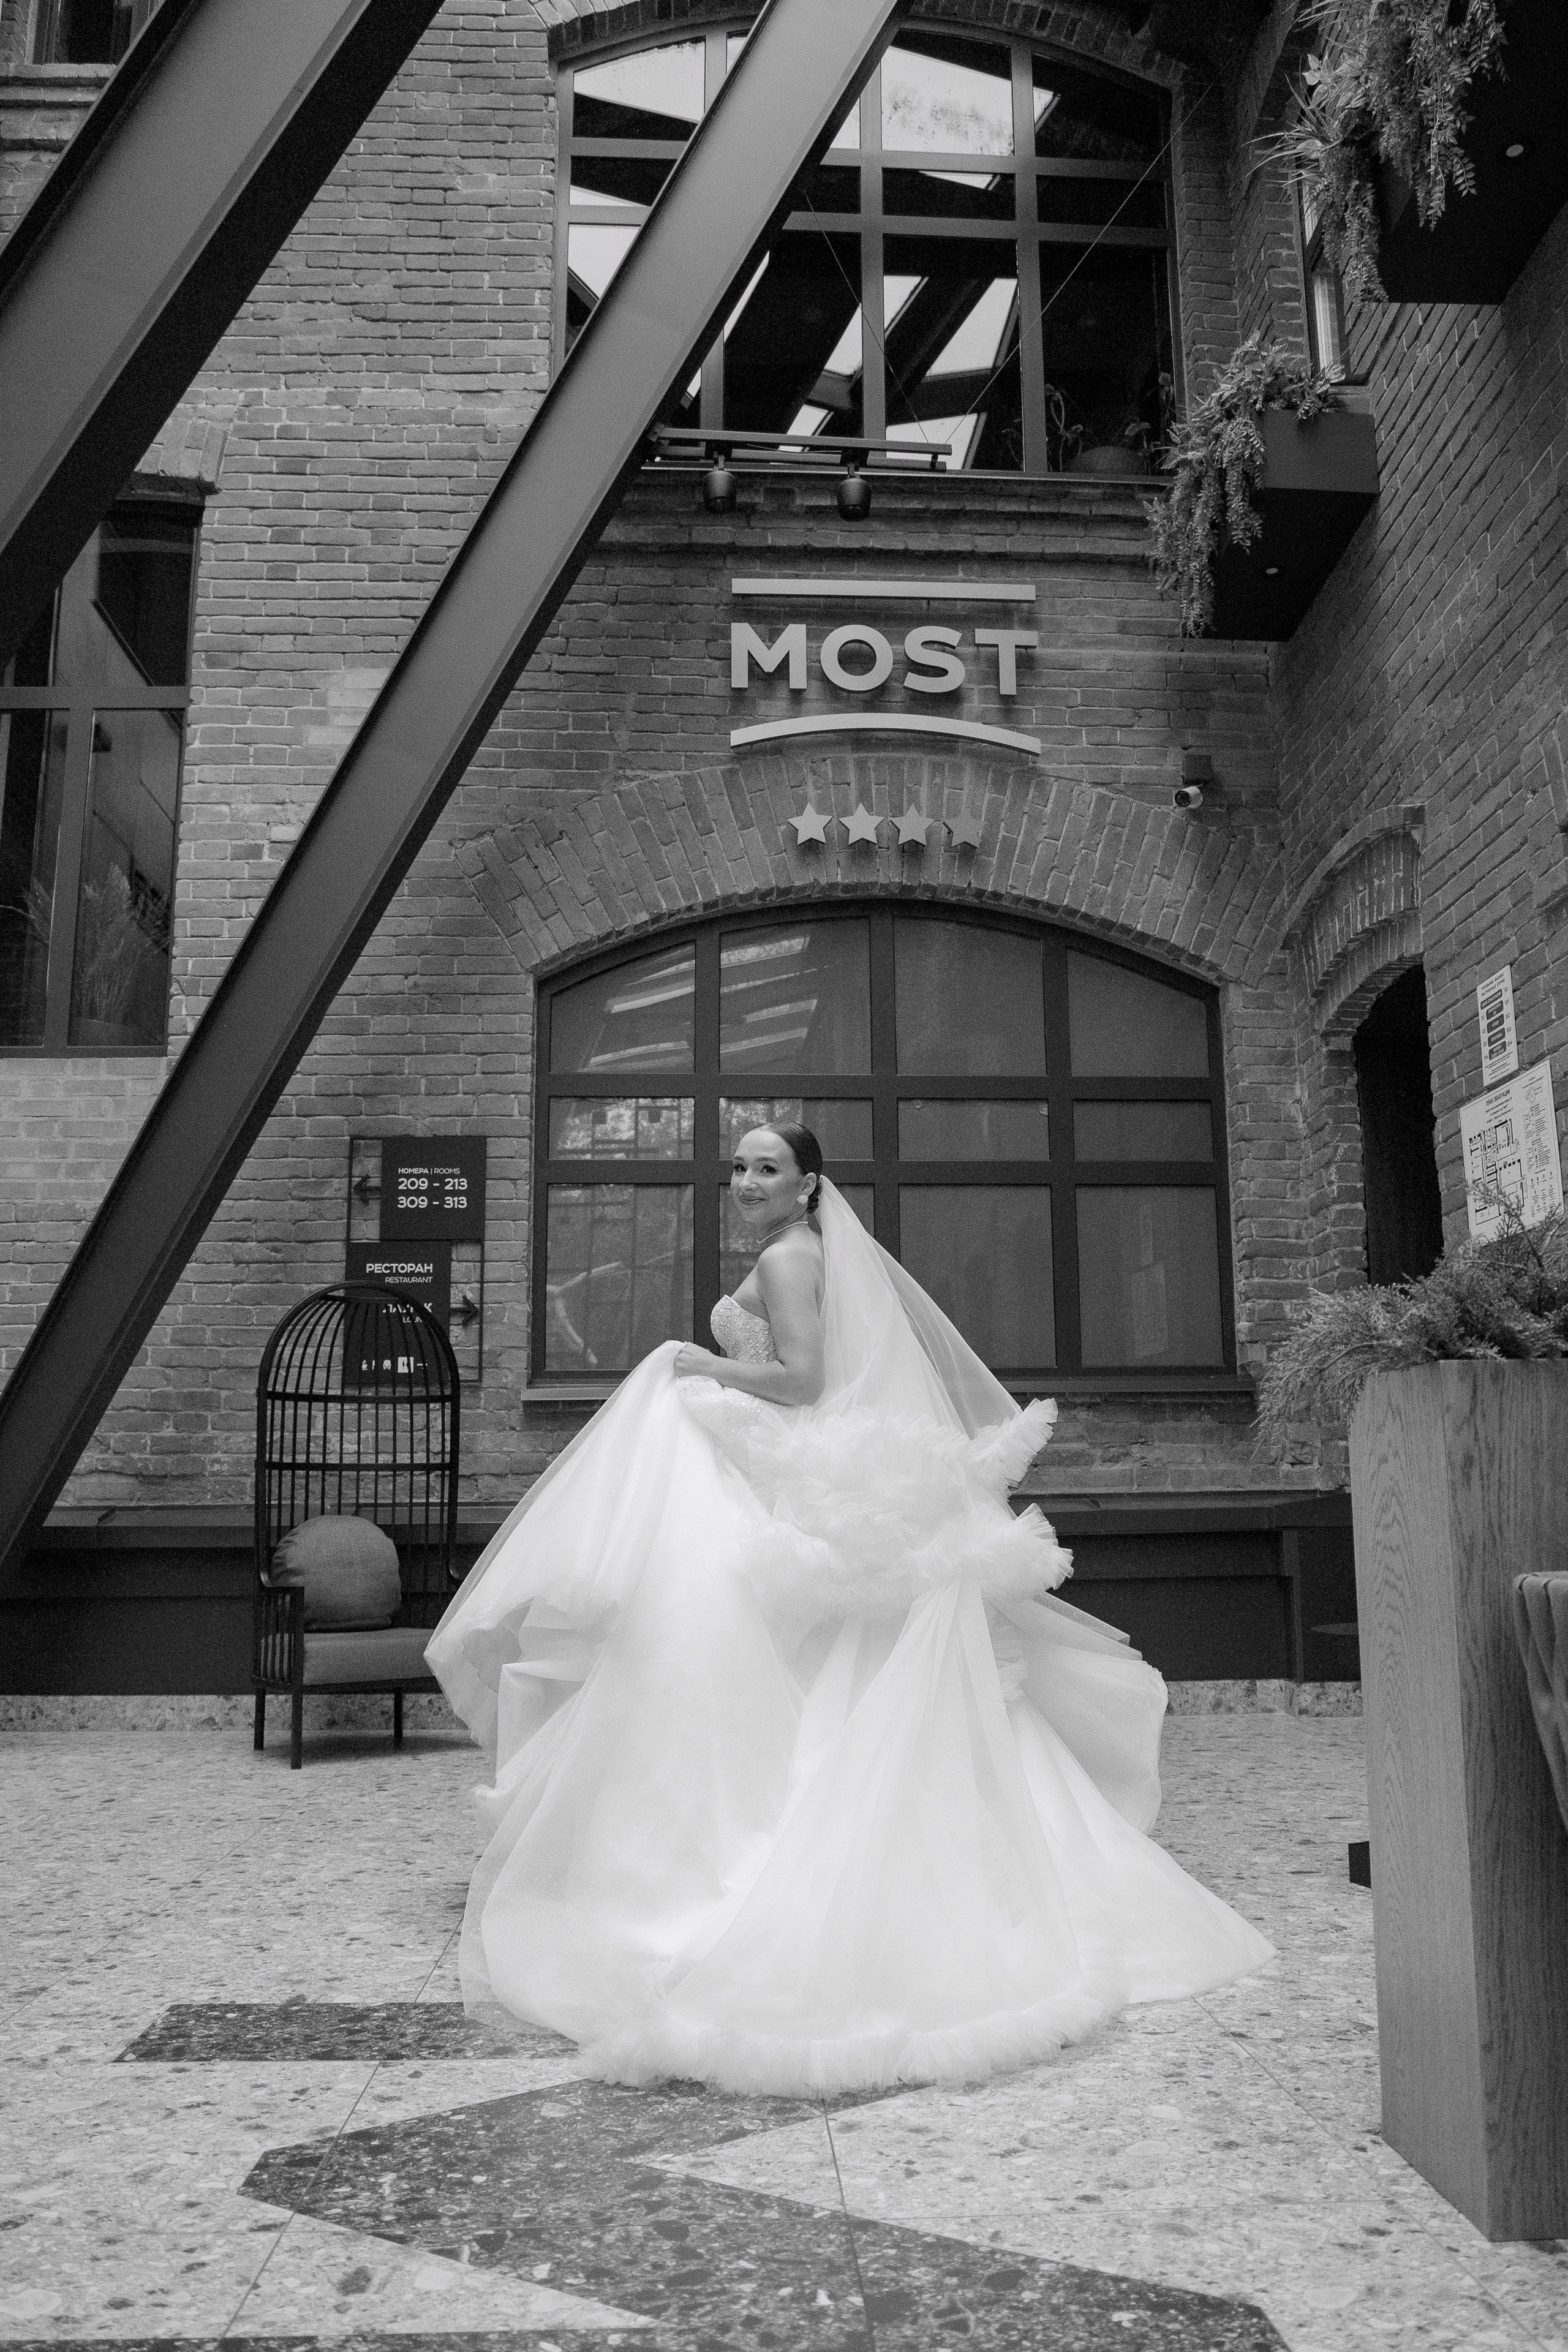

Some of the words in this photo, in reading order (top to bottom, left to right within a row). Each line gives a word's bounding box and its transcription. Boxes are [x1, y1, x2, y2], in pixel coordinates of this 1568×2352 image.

[731, 622, 1038, 695] MOST
[398, 1178, 428, 1189] 209
[444, 1178, 468, 1190] 213
[398, 1196, 428, 1208] 309
[444, 1196, 467, 1208] 313
[366, 1263, 433, 1273] РЕСТОРАН
